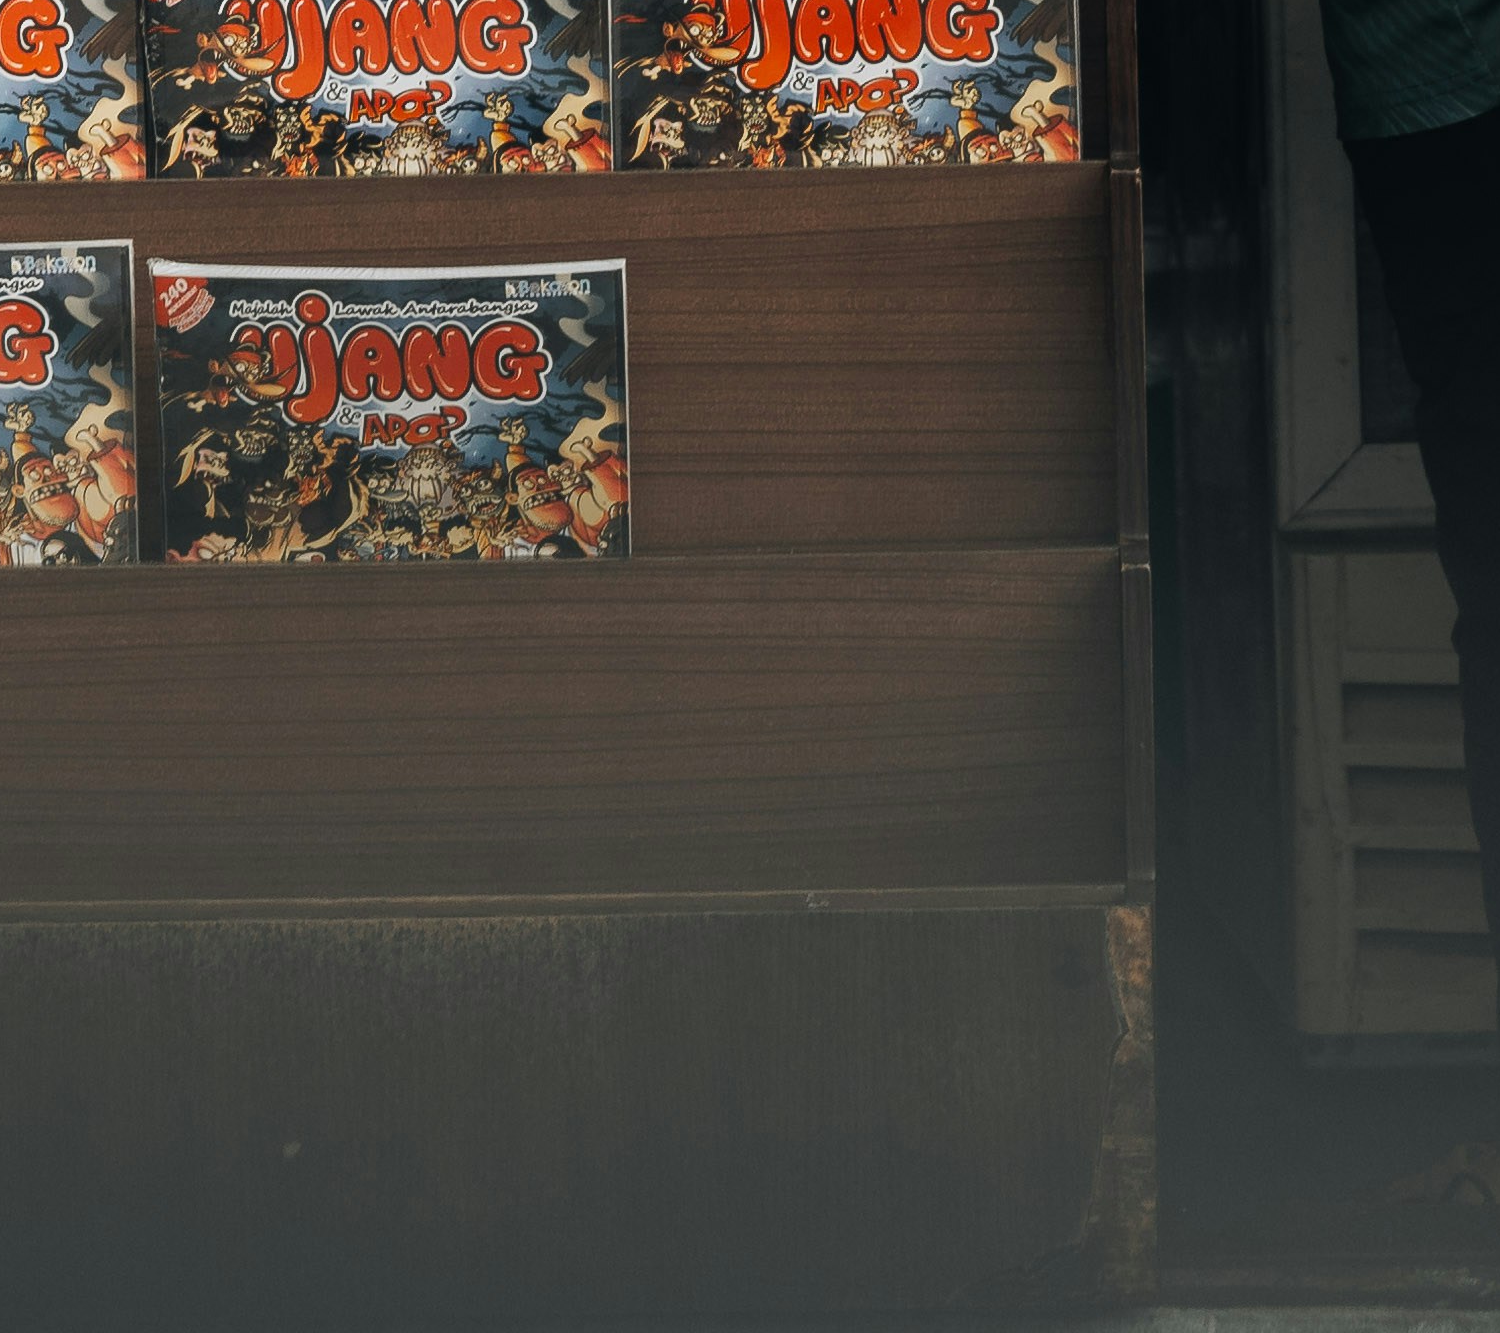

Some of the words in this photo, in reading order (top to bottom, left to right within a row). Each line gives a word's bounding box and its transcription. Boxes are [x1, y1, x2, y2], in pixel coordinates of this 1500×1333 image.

[794, 72, 813, 89] &
[326, 82, 348, 100] &
[159, 277, 190, 309] 240
[229, 300, 293, 318] Majalah
[334, 300, 397, 316] Lawak
[403, 299, 537, 318] Antarabangsa
[340, 406, 361, 425] &
